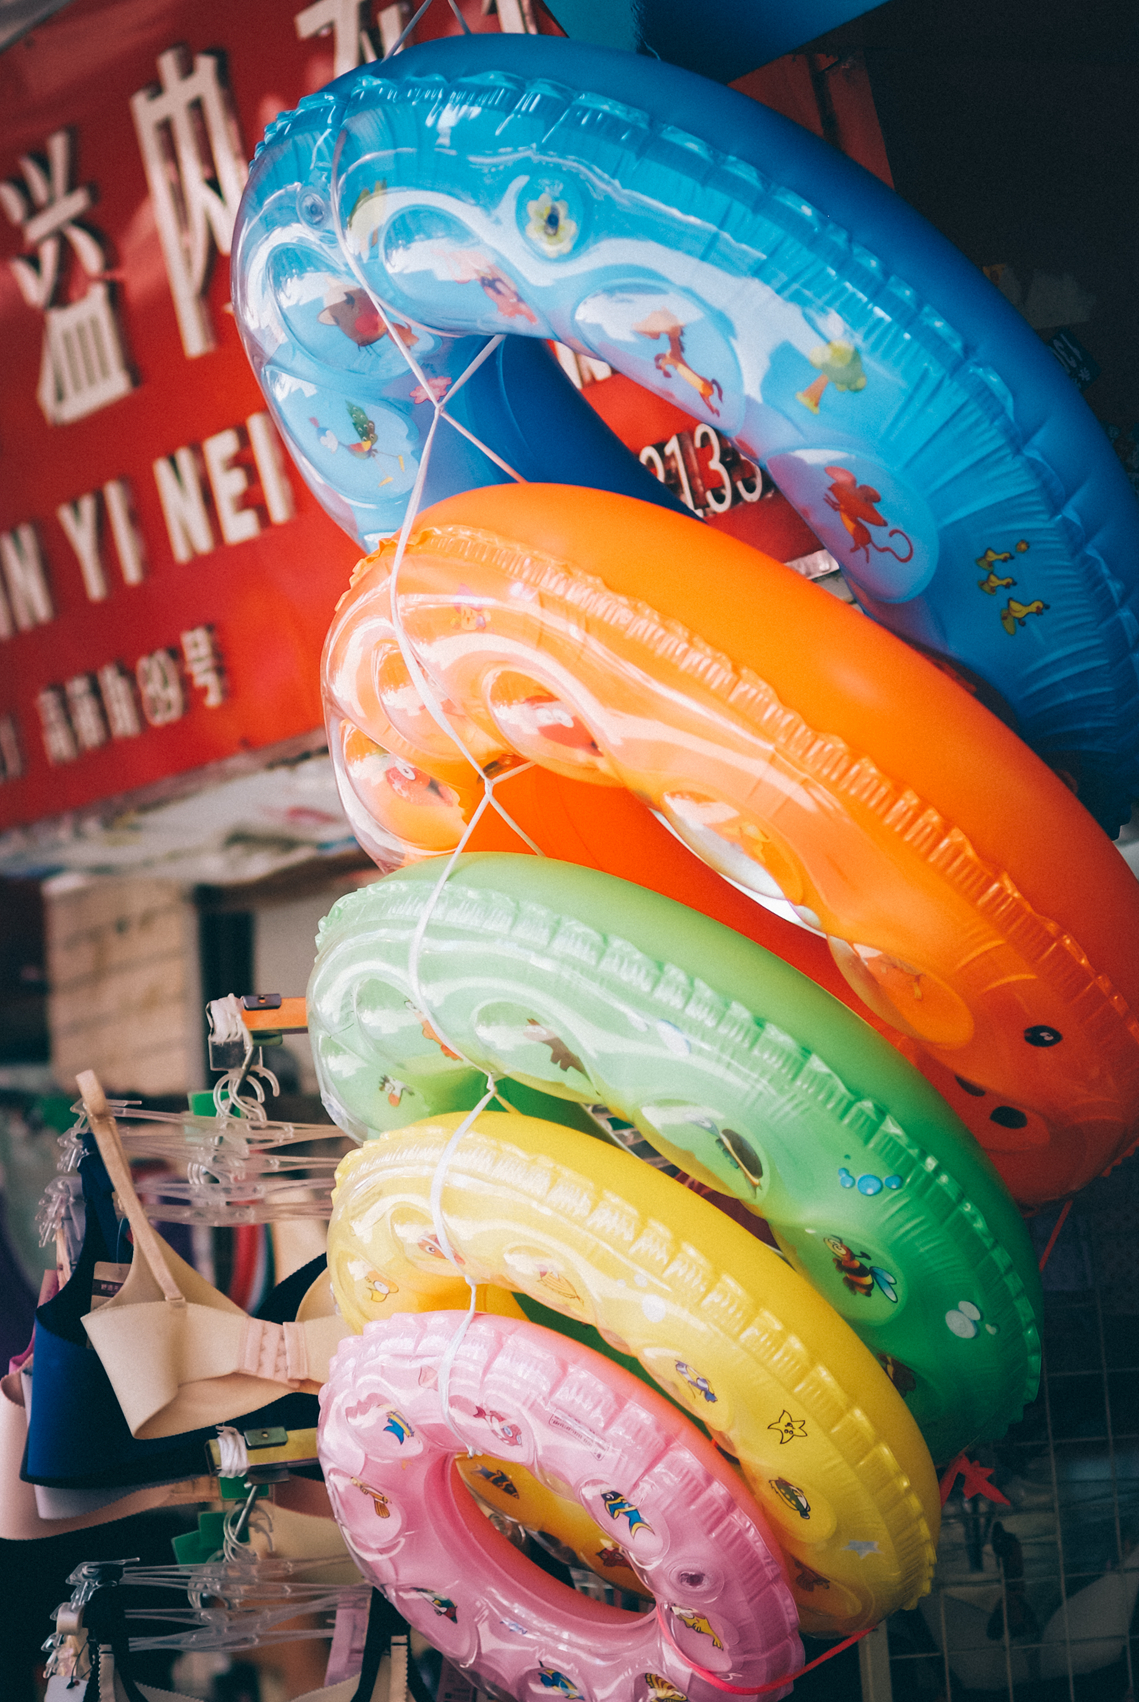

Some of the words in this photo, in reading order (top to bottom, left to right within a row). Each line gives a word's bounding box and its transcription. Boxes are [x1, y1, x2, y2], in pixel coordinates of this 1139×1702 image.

[0, 522, 56, 642] N
[56, 479, 144, 603] YI
[152, 411, 293, 565] NEI
